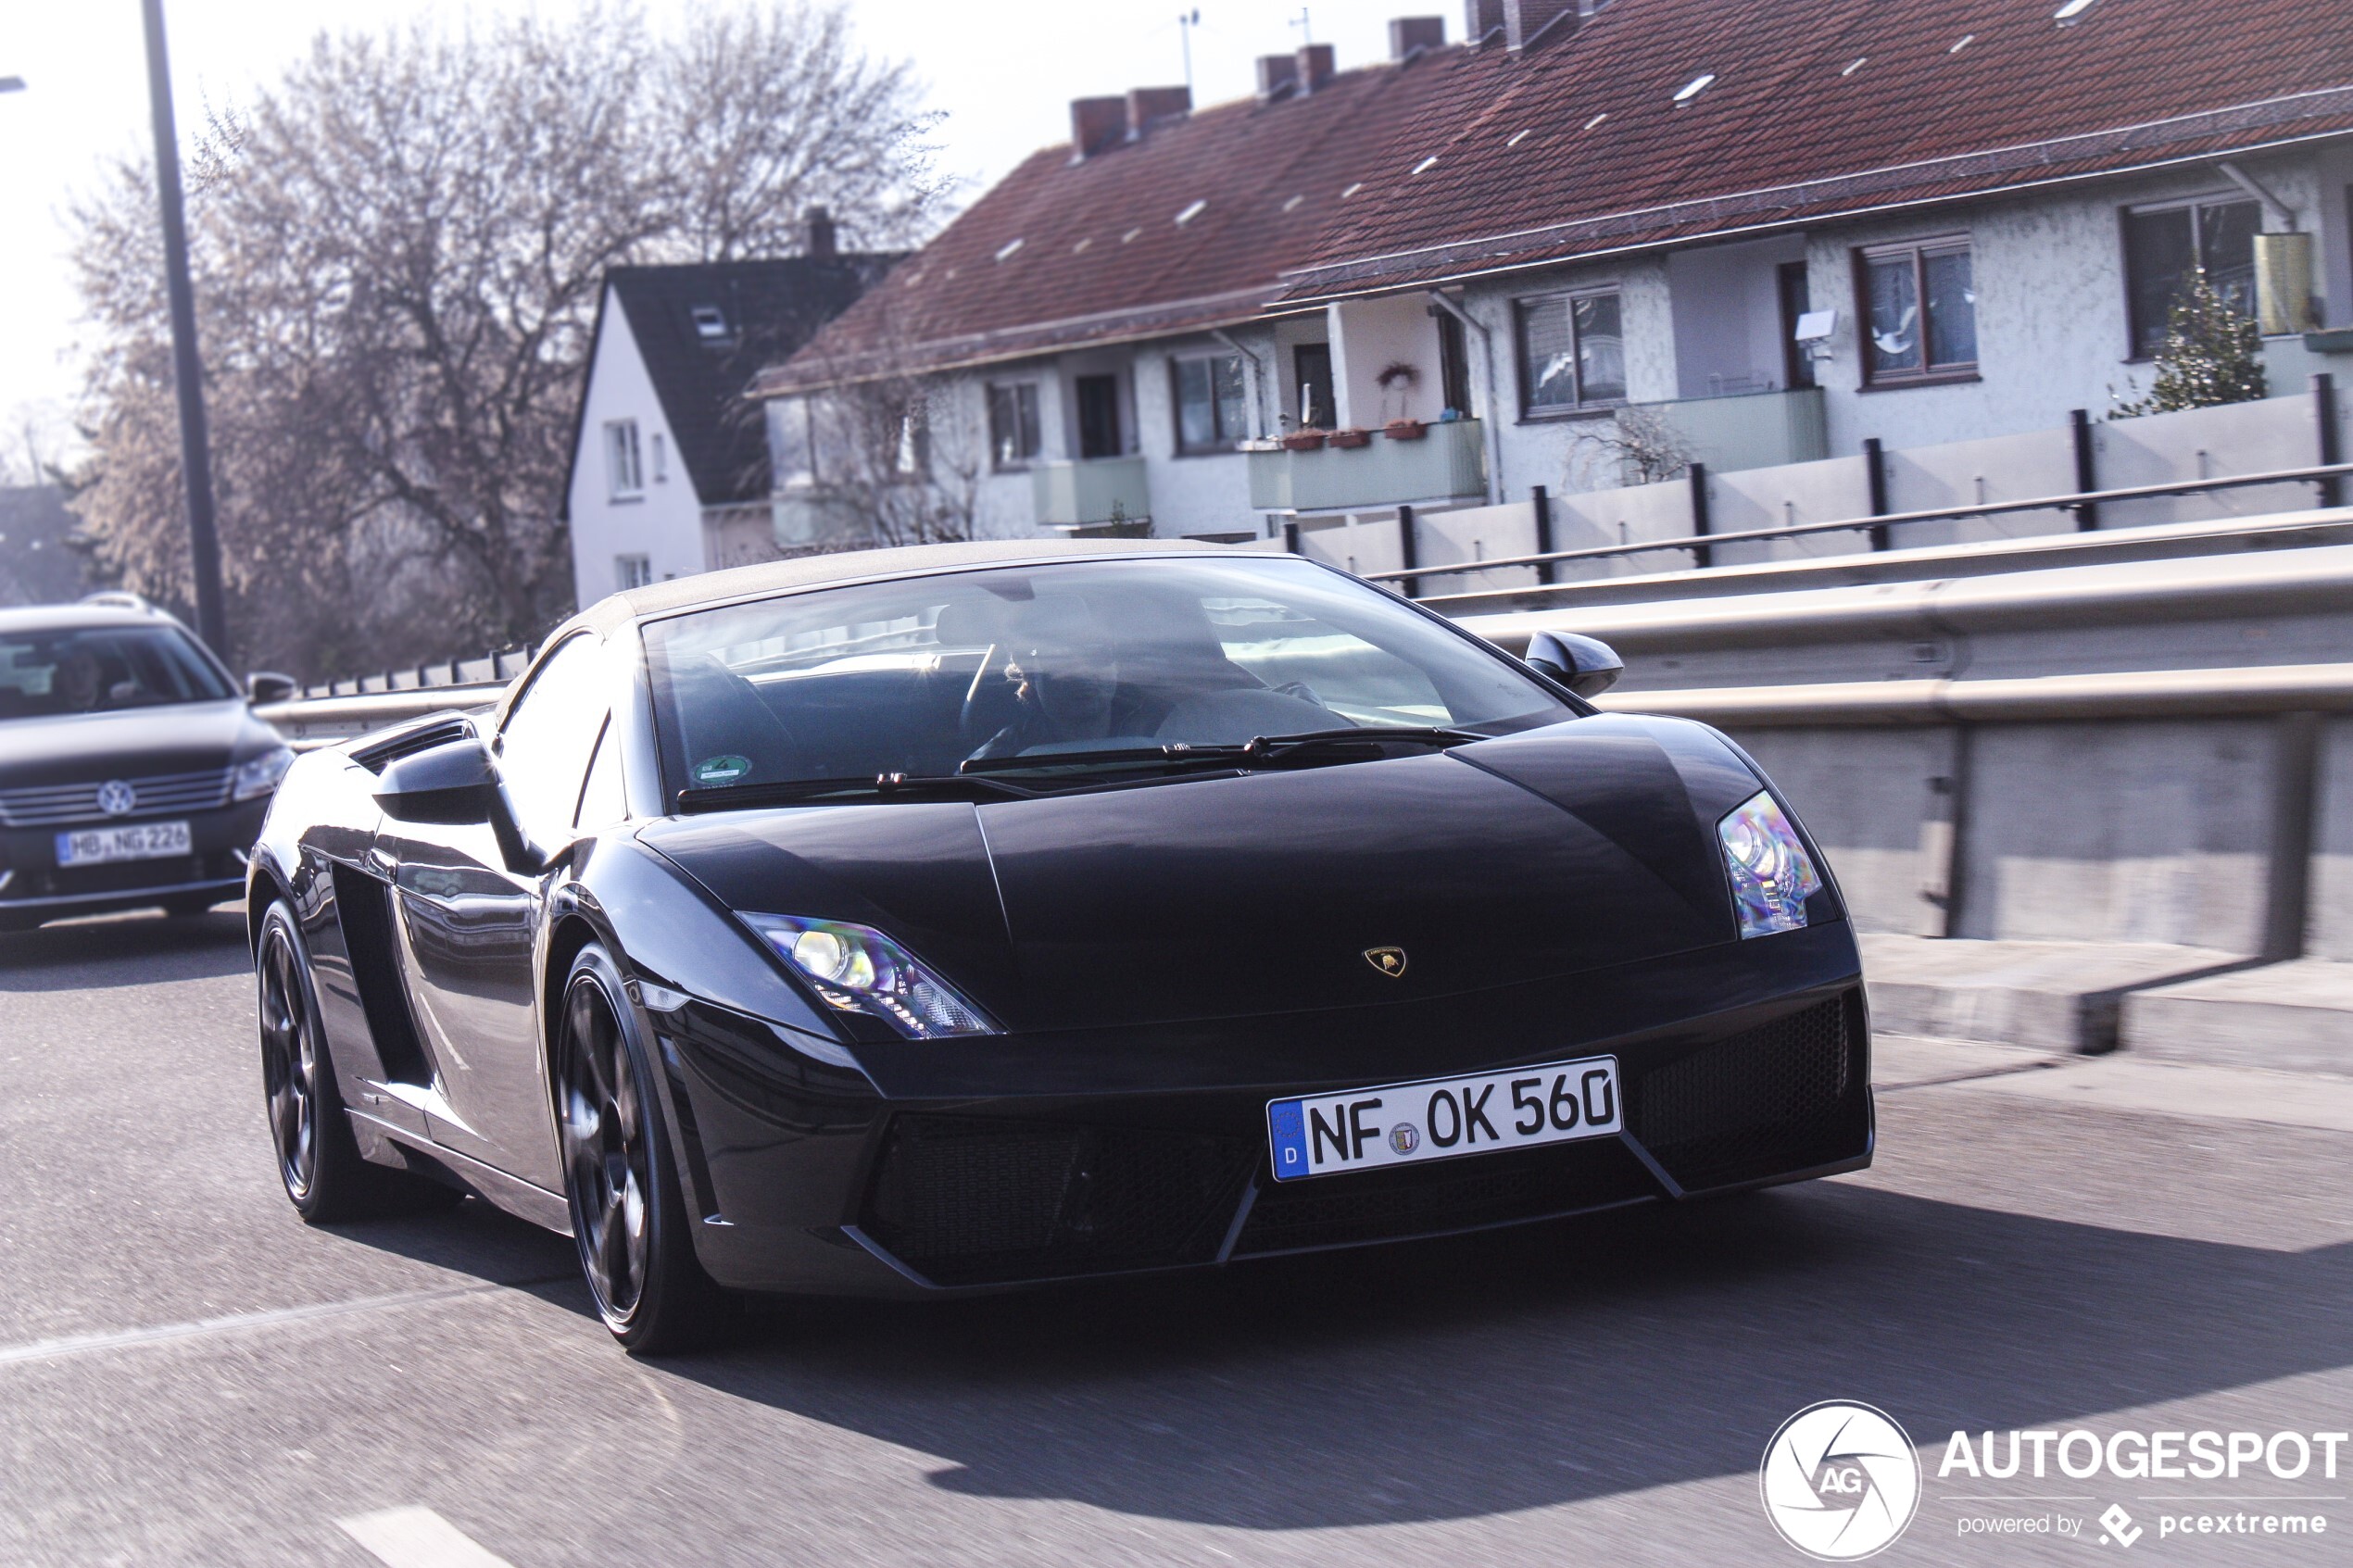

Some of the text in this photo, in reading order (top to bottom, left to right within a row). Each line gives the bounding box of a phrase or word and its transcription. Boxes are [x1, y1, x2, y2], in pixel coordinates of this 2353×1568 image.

[72, 834, 102, 858] HB
[1310, 1098, 1383, 1164] NF
[1428, 1084, 1500, 1148] OK
[1511, 1069, 1615, 1136] 560
[1285, 1148, 1298, 1164] D
